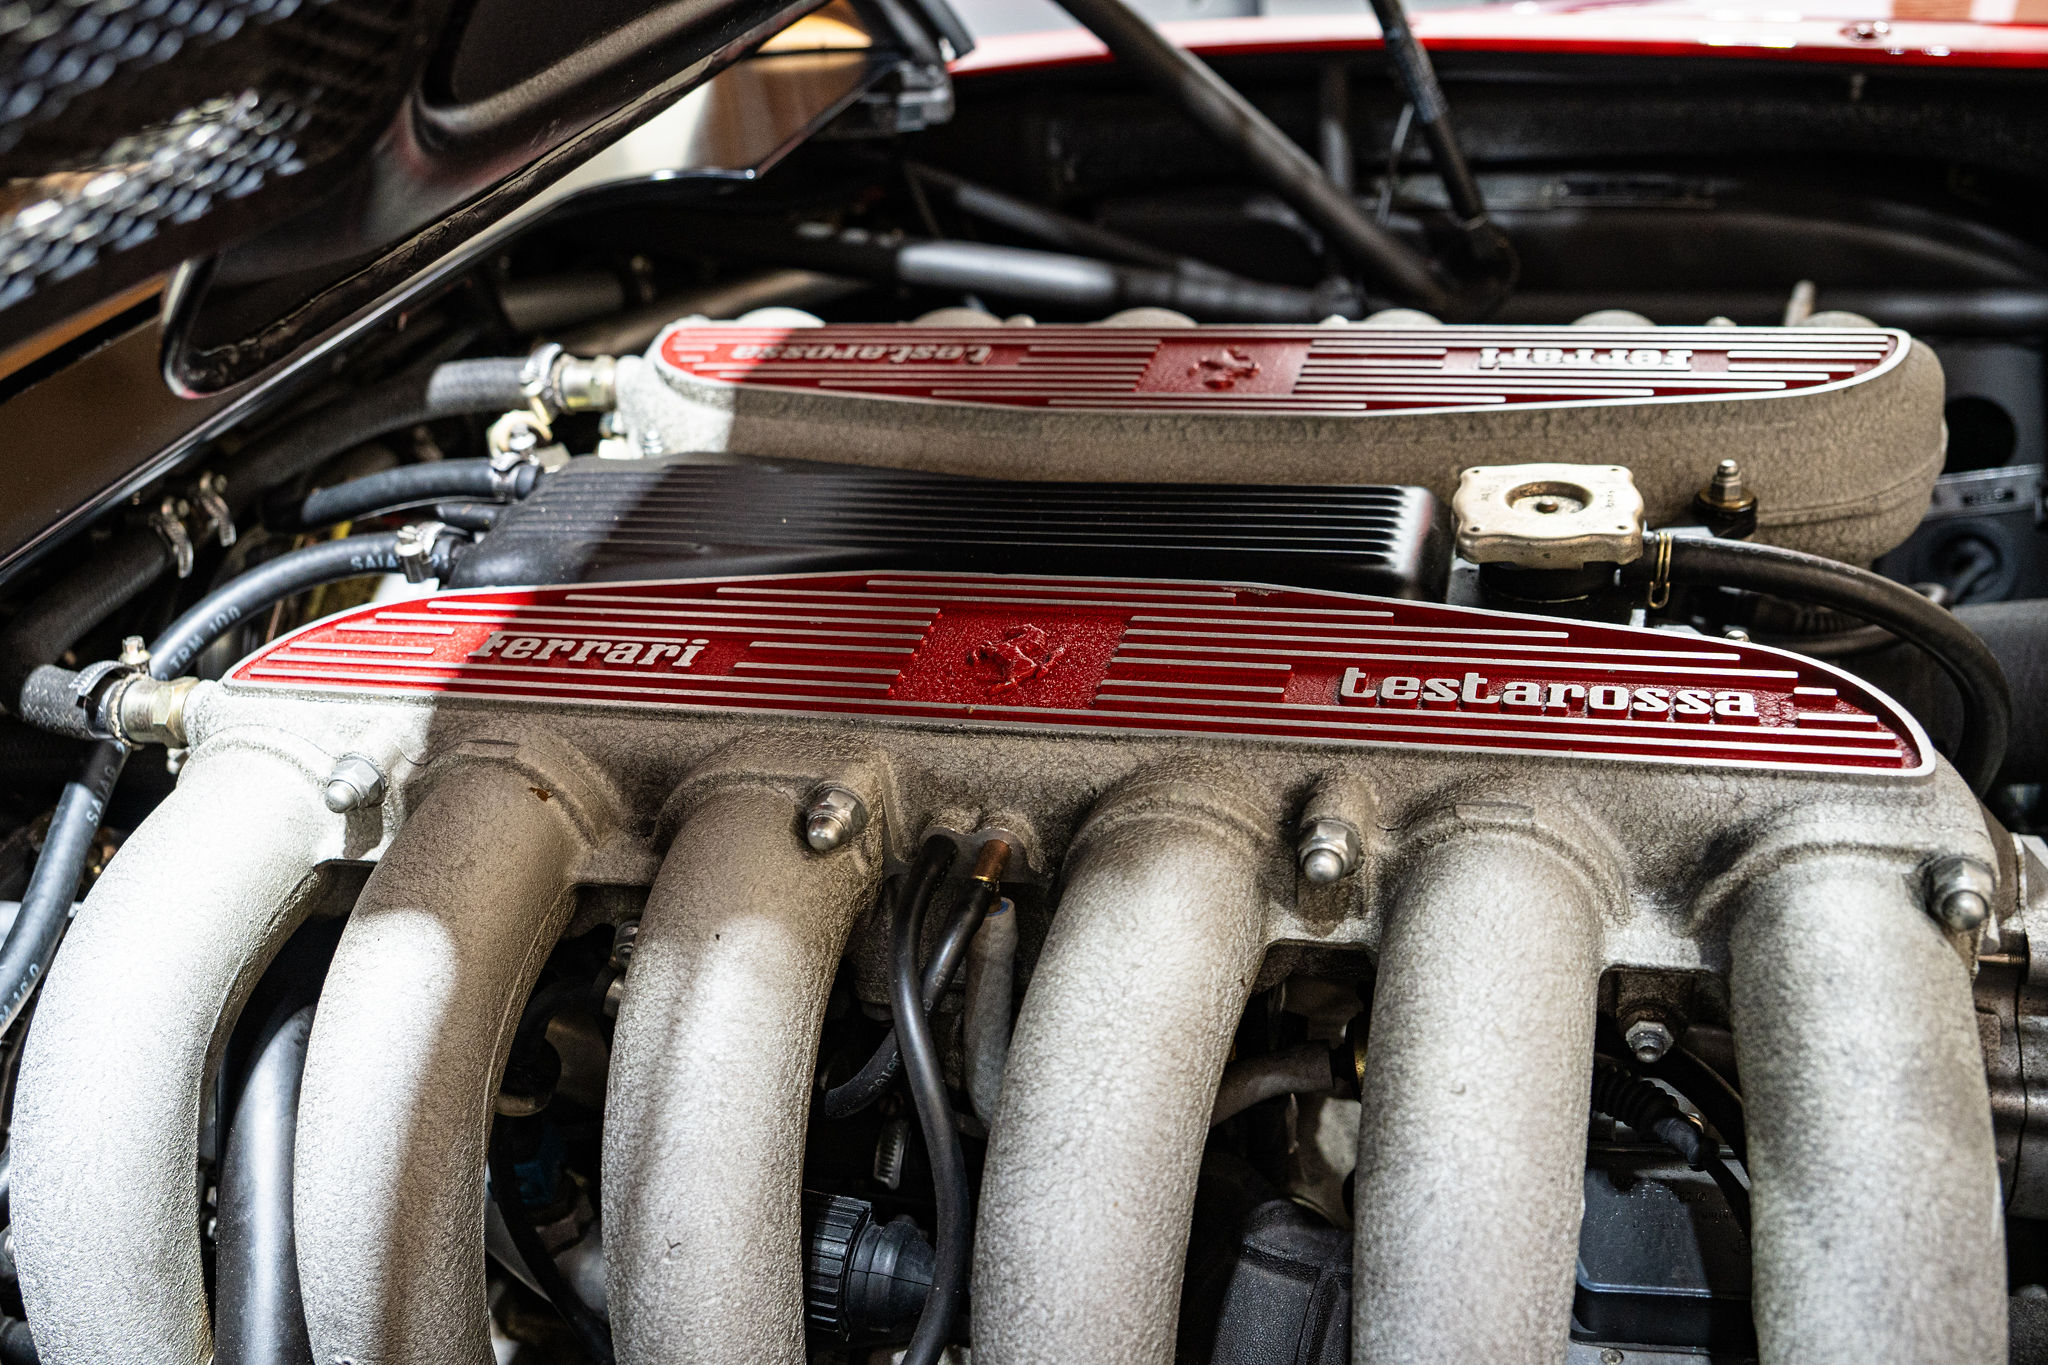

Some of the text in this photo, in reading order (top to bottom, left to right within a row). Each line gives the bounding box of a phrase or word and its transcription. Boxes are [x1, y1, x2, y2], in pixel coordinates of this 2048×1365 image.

[731, 344, 1693, 370] Ferrari testarossa
[350, 552, 399, 569] SAIA
[169, 632, 205, 669] TRM
[468, 631, 1760, 718] Ferrari testarossa
